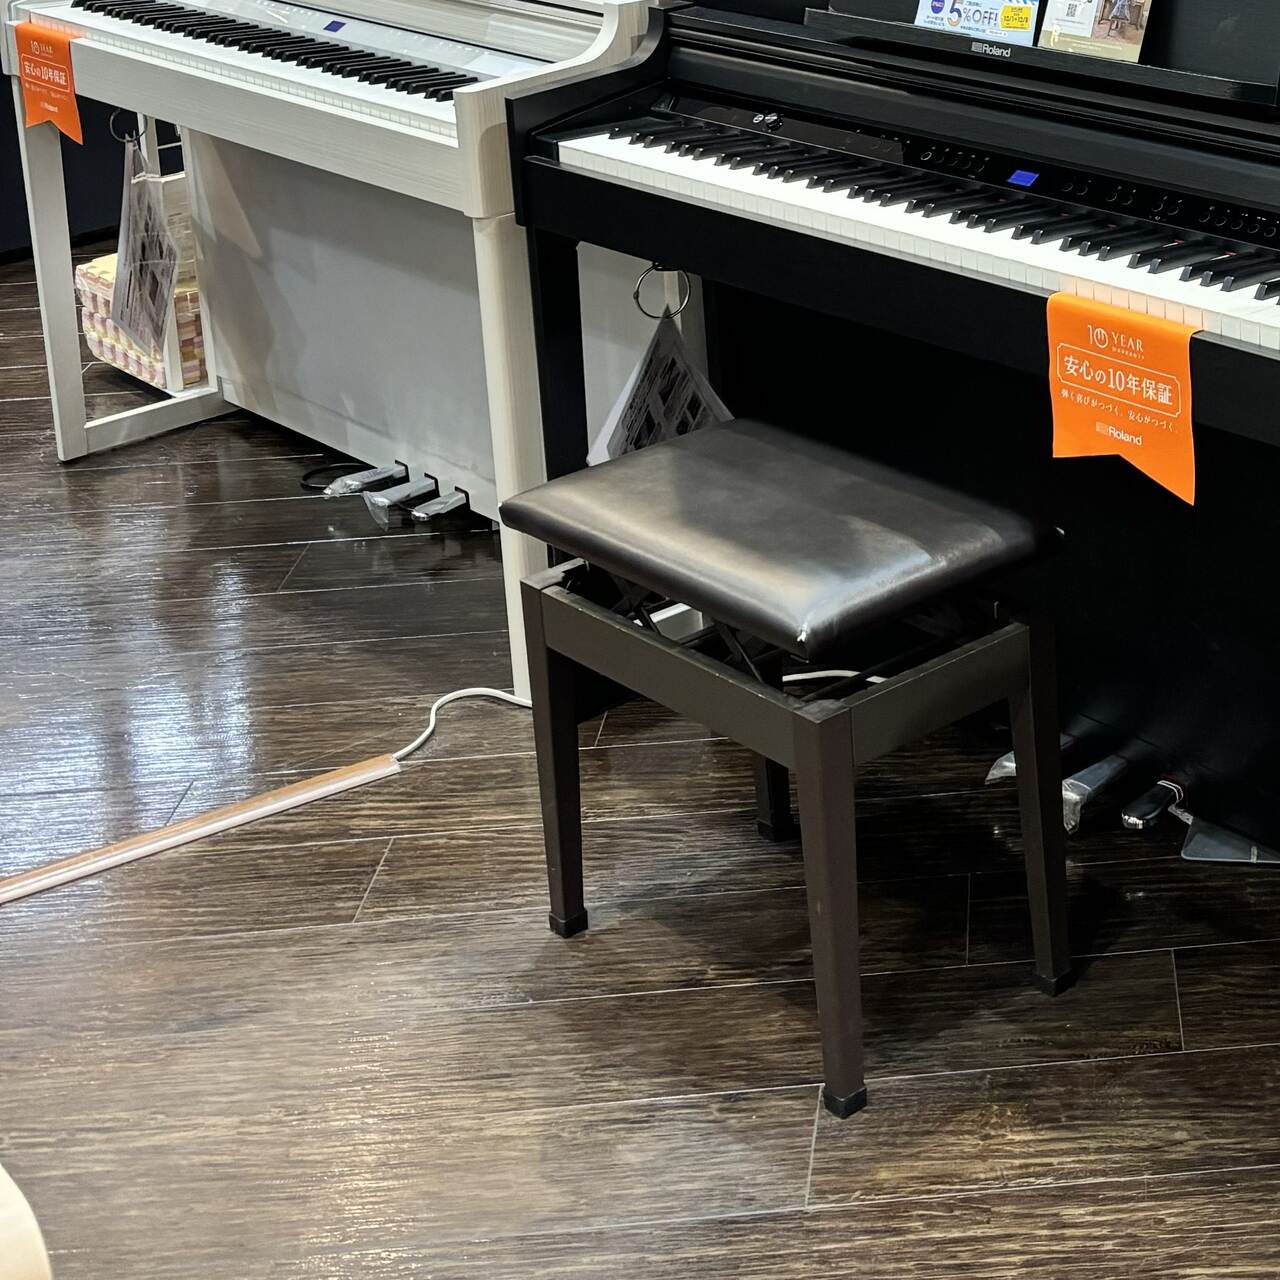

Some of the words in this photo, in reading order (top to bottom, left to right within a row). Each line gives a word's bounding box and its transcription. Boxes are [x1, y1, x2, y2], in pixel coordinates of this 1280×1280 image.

[982, 43, 1011, 58] Roland
[24, 63, 67, 85] 安心の10年保証
[1087, 324, 1109, 348] 10
[1111, 331, 1144, 352] YEAR
[1063, 354, 1173, 406] 安心の10年保証
[1108, 426, 1143, 446] Roland
